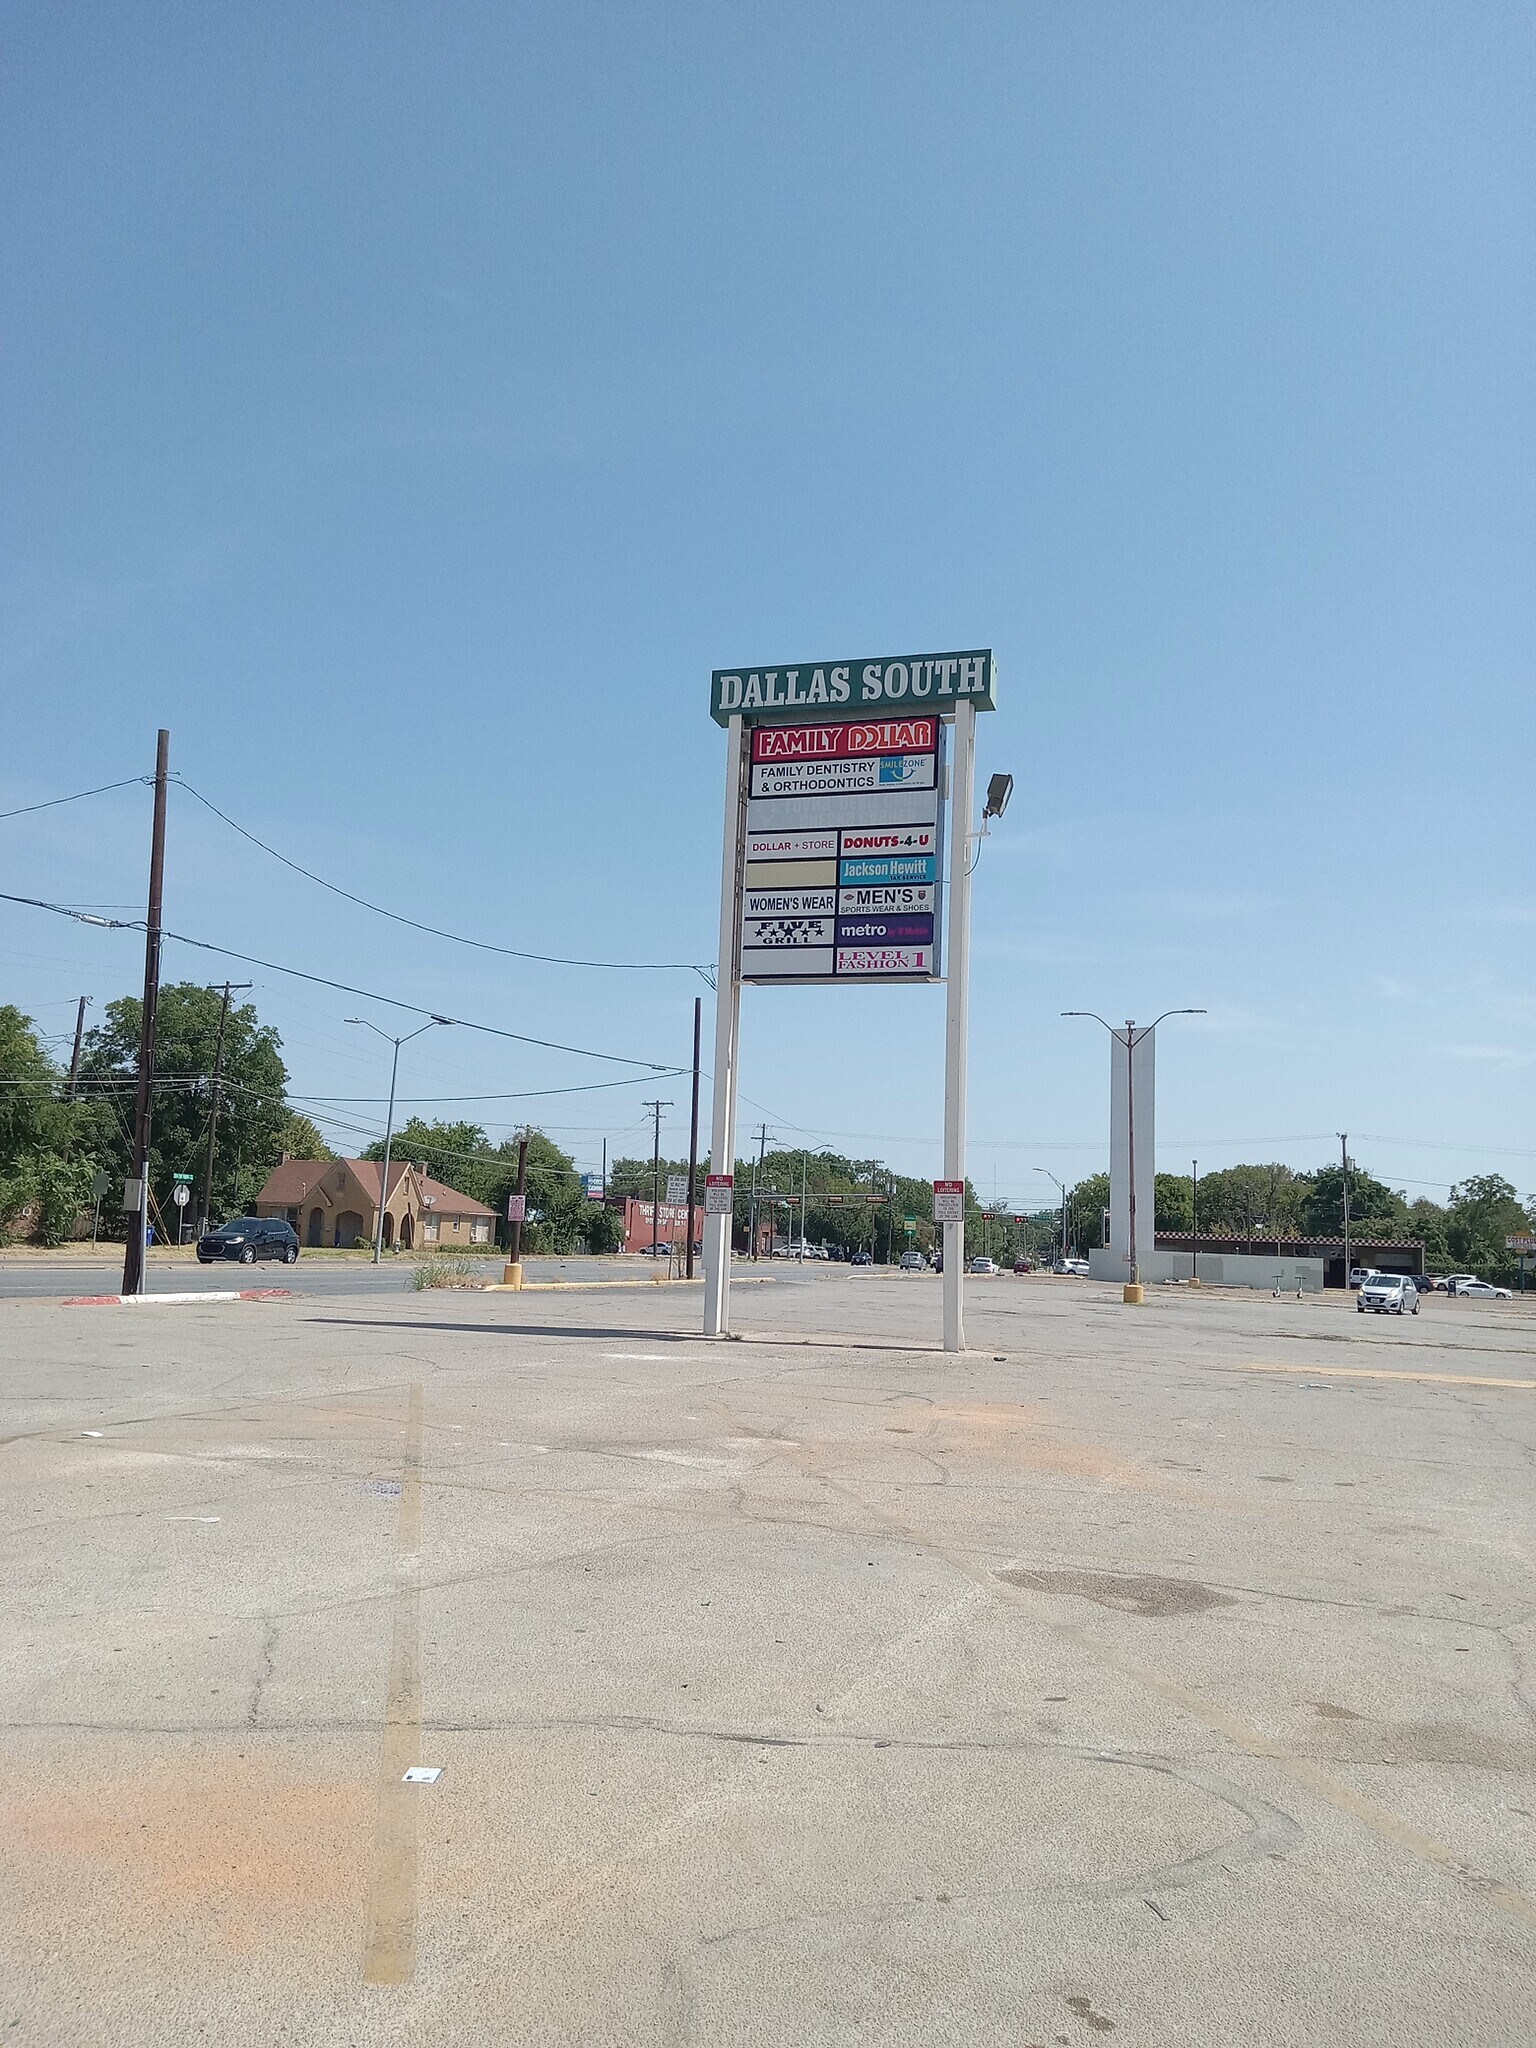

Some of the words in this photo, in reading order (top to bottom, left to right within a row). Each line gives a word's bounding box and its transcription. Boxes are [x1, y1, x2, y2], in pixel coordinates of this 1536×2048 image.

[719, 667, 850, 709] DALLAS
[862, 657, 985, 700] SOUTH
[759, 728, 843, 756] FAMILY
[848, 722, 931, 750] DOLLAR
[761, 766, 803, 778] FAMILY
[806, 762, 875, 775] DENTISTRY
[761, 782, 769, 792] &
[774, 777, 874, 791] ORTHODONTICS
[753, 842, 791, 851] DOLLAR
[802, 840, 834, 849] STORE
[844, 862, 888, 876] Jackson
[890, 859, 926, 875] Hewitt
[750, 897, 799, 910] WOMEN'S
[802, 896, 834, 909] WEAR
[857, 889, 913, 904] MEN'S
[761, 921, 821, 929] FIVE
[842, 924, 886, 936] metro
[839, 951, 908, 960] LEVEL
[912, 952, 927, 967] 1
[838, 960, 909, 969] FASHION
